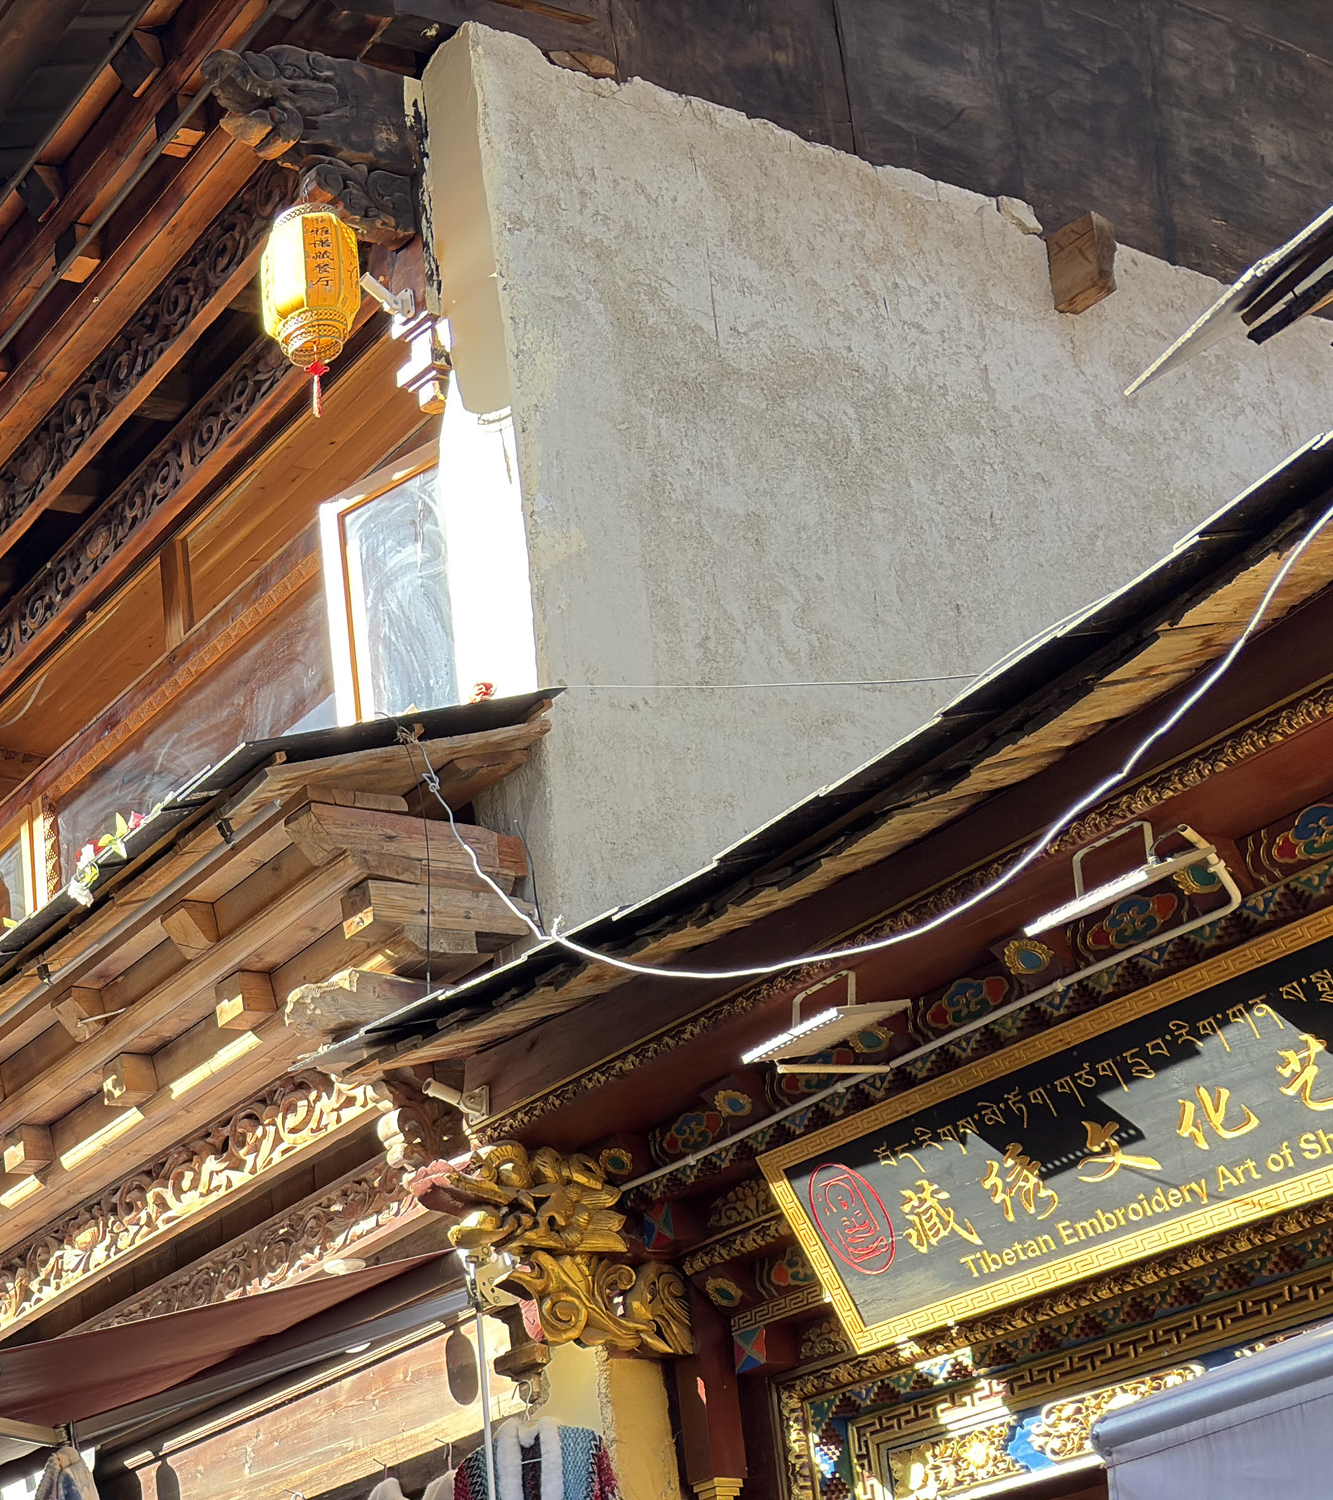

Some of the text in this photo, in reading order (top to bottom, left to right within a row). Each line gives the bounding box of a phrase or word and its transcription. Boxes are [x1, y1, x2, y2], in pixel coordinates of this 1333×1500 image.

[960, 1231, 1056, 1278] Tibetan
[1056, 1178, 1209, 1246] Embroidery
[1217, 1157, 1262, 1192] Art
[1267, 1140, 1295, 1172] of
